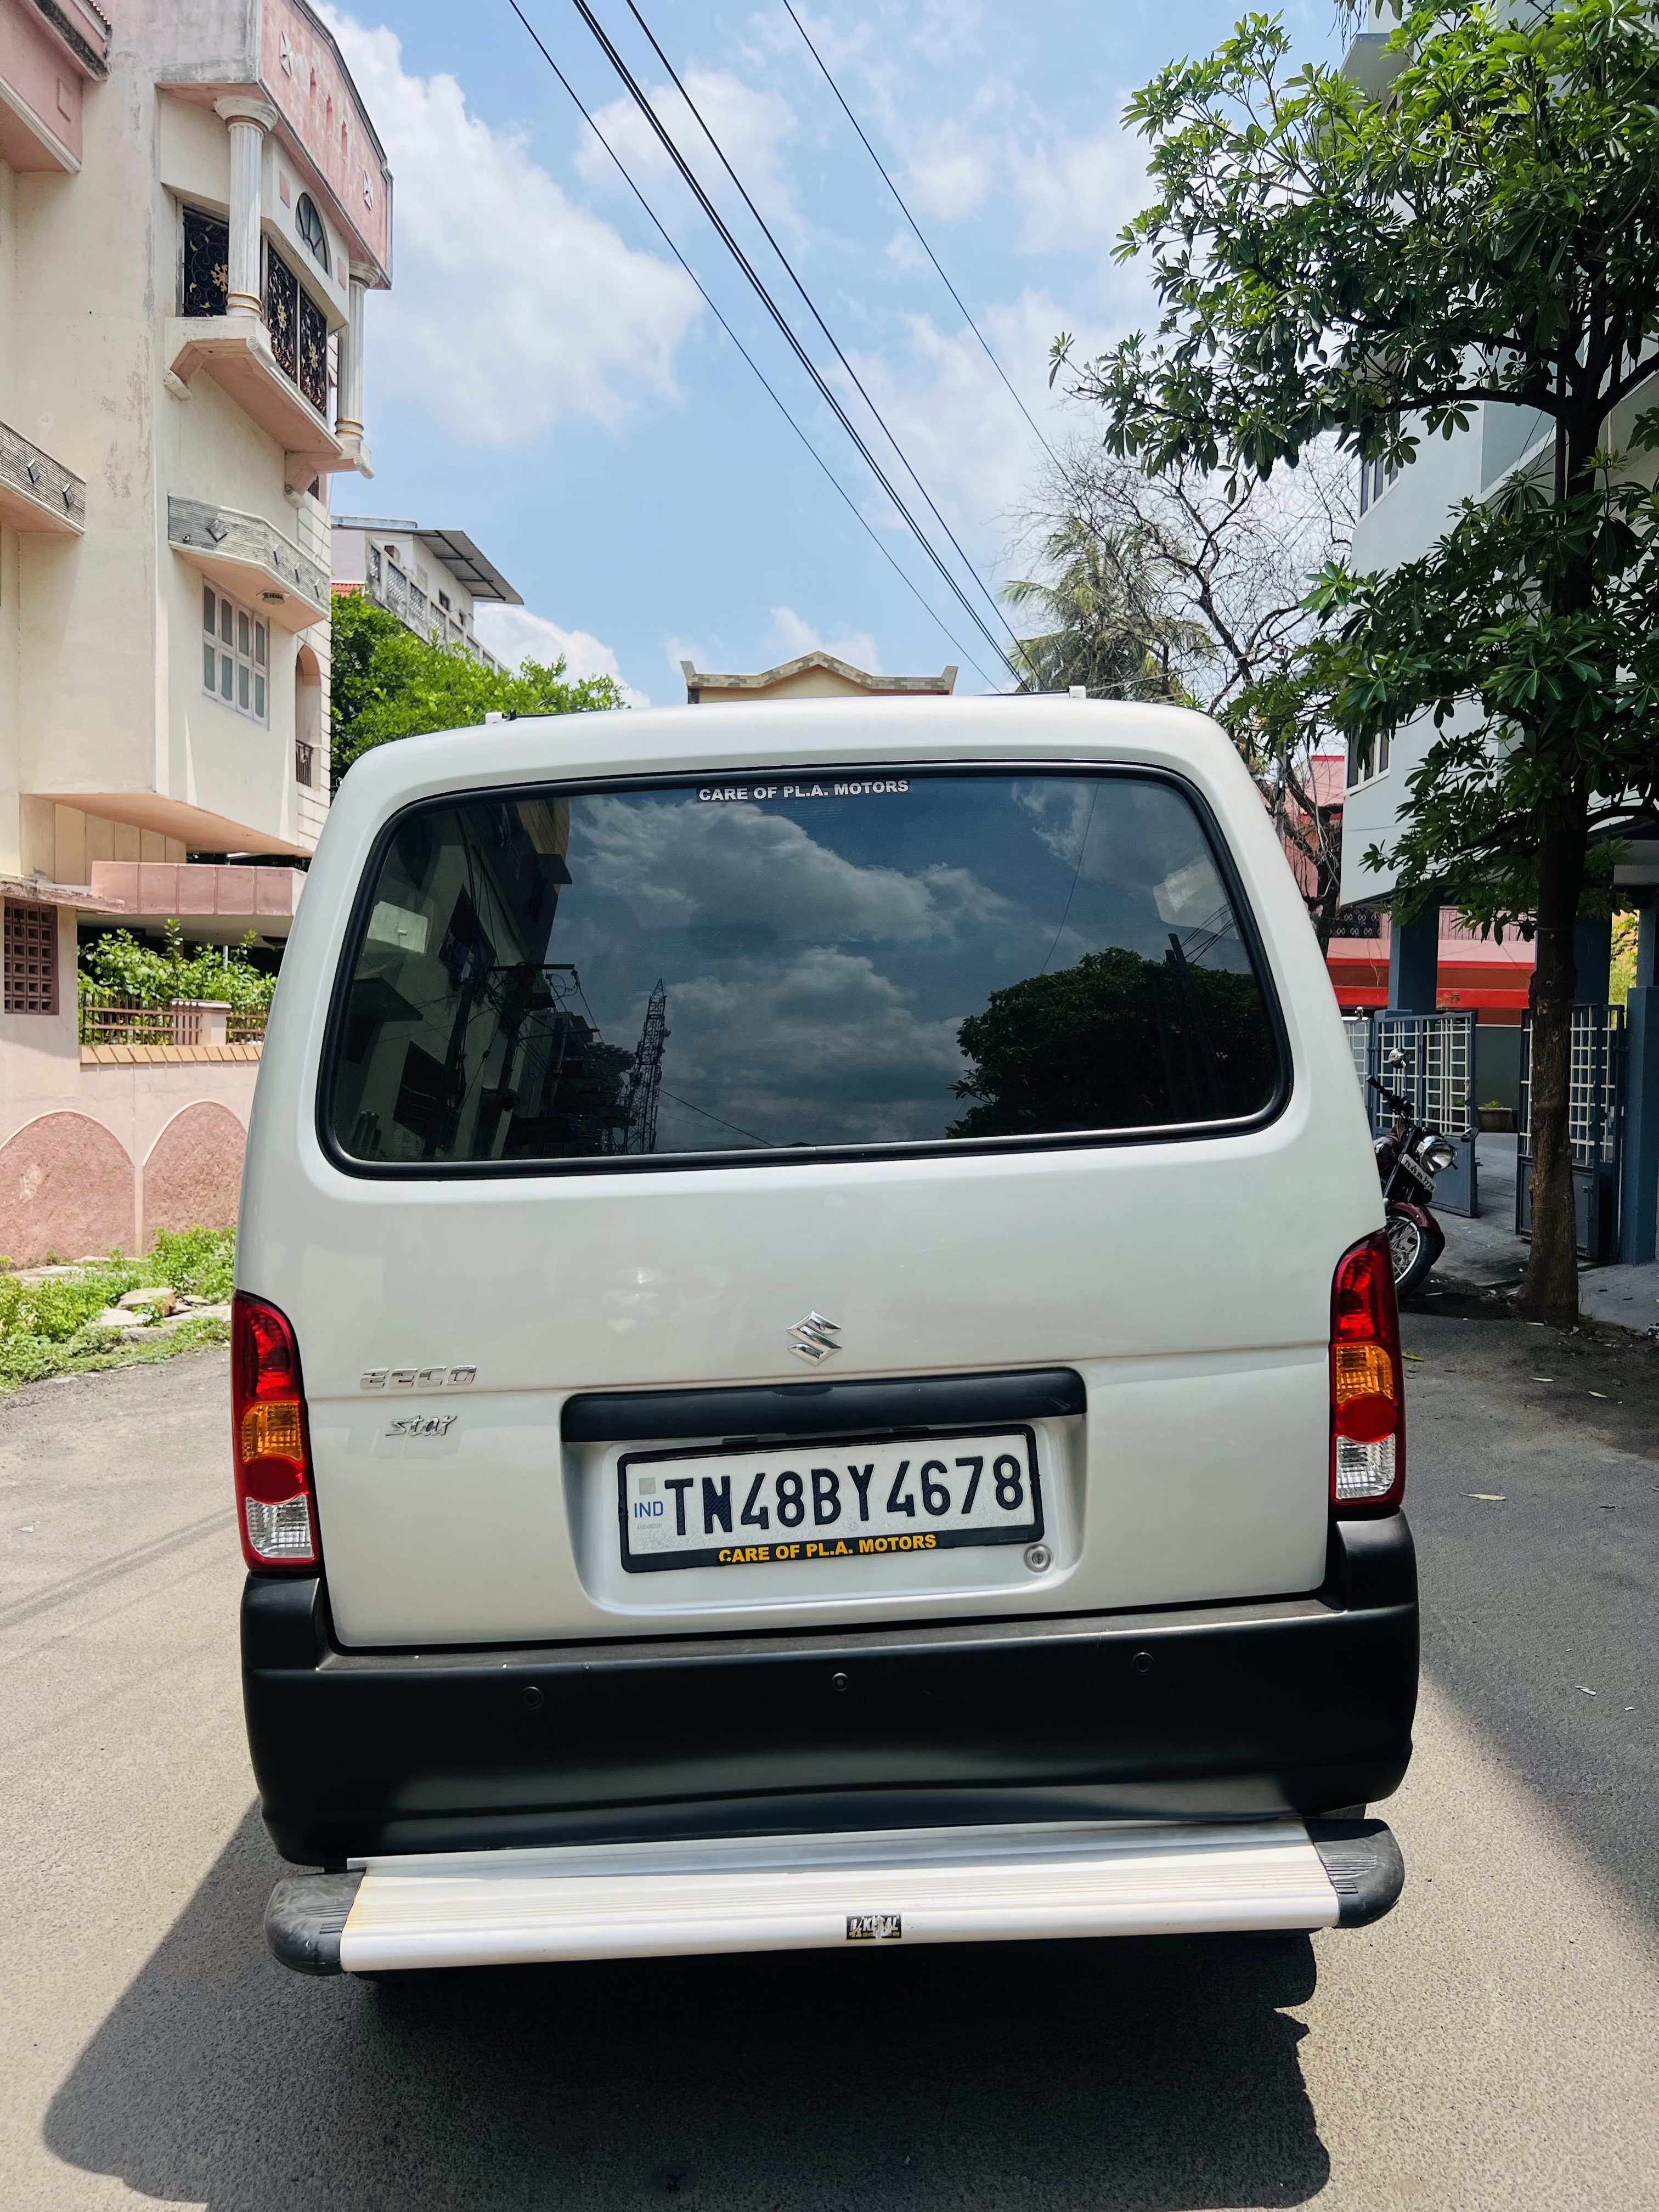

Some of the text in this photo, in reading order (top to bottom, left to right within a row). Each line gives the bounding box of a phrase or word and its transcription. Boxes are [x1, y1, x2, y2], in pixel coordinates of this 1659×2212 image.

[699, 787, 748, 801] CARE
[753, 787, 777, 799] OF
[834, 780, 909, 796] MOTORS
[360, 1364, 476, 1389] EECO
[664, 1453, 1024, 1536] TN48BY4678
[634, 1500, 664, 1518] IND
[719, 1547, 770, 1563] CARE
[775, 1544, 800, 1559] OF
[859, 1534, 936, 1553] MOTORS
